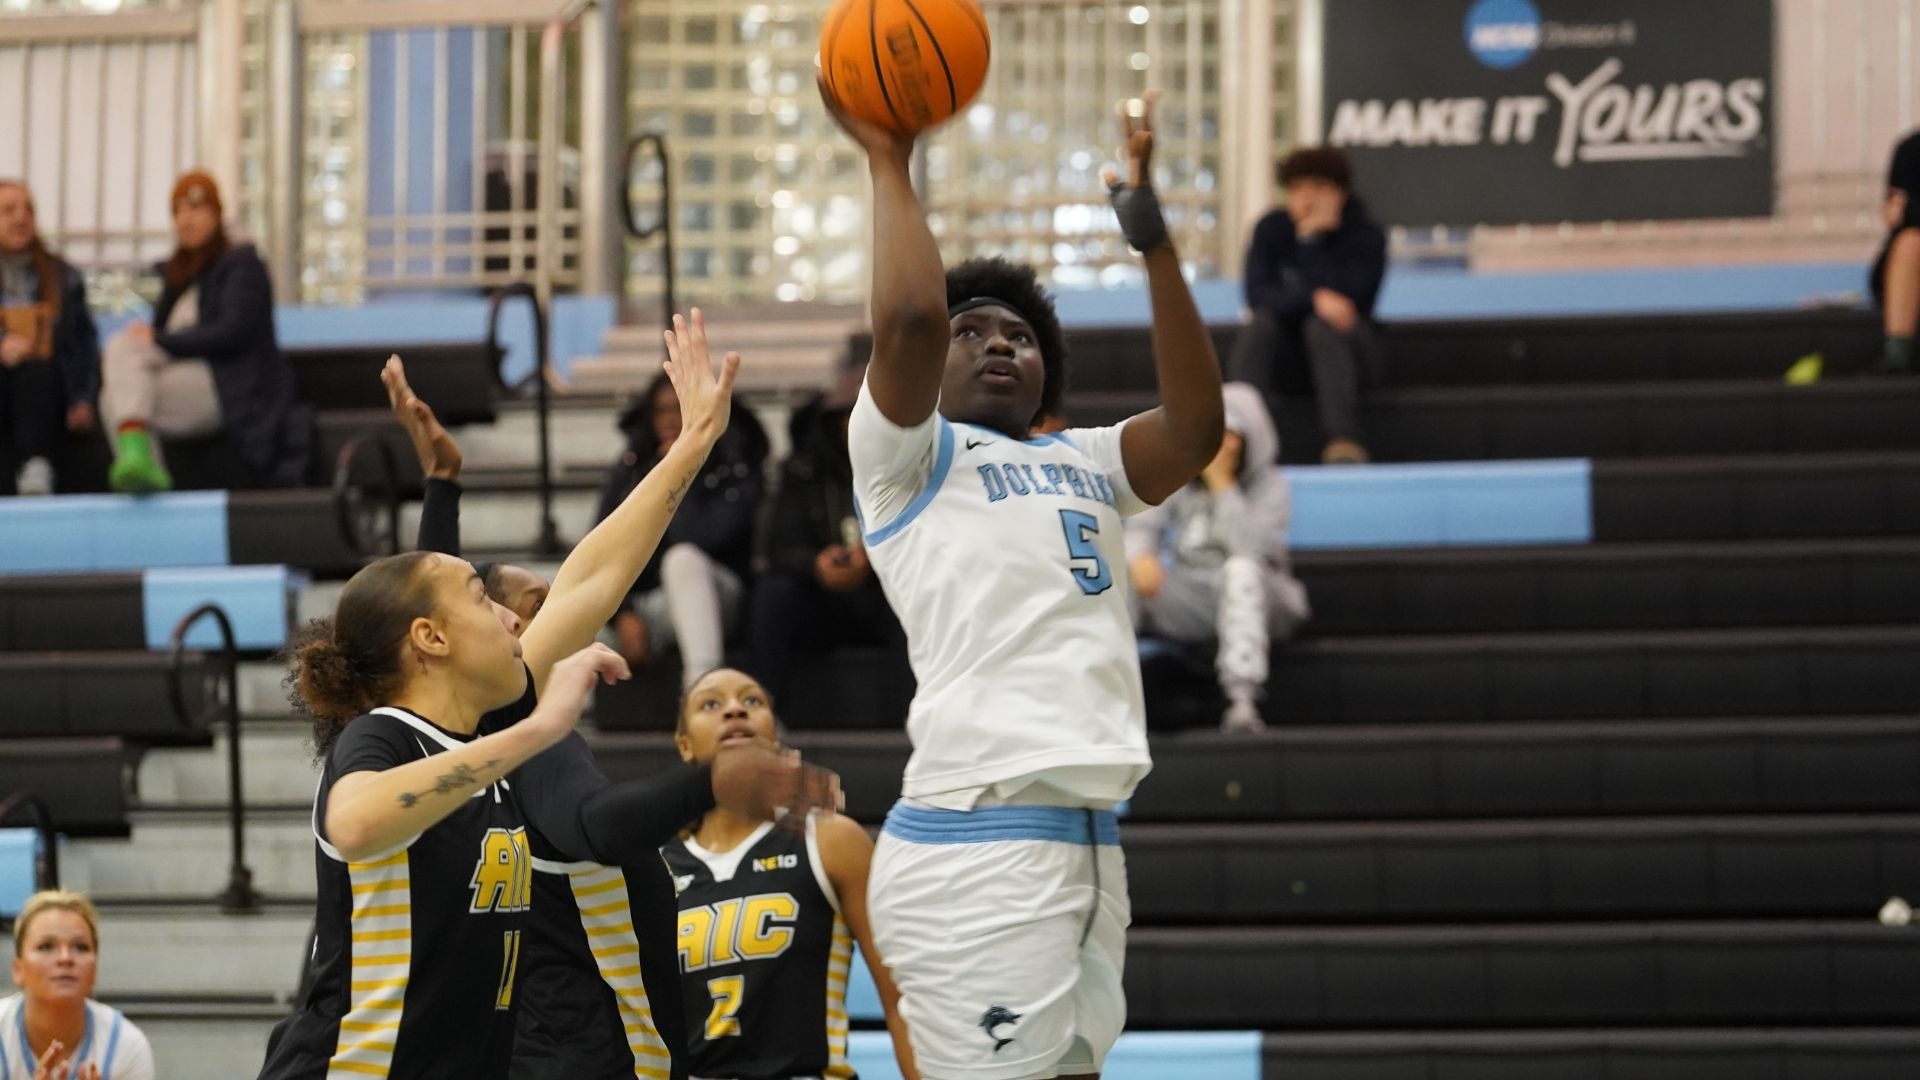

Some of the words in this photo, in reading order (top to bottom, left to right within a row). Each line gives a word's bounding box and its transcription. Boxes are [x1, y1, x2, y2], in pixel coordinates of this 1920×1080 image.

[1331, 98, 1484, 147] MAKE
[1491, 94, 1547, 143] IT
[1545, 56, 1765, 168] YOURS
[1058, 509, 1113, 595] 5
[677, 892, 800, 975] AIC
[704, 974, 745, 1041] 2
